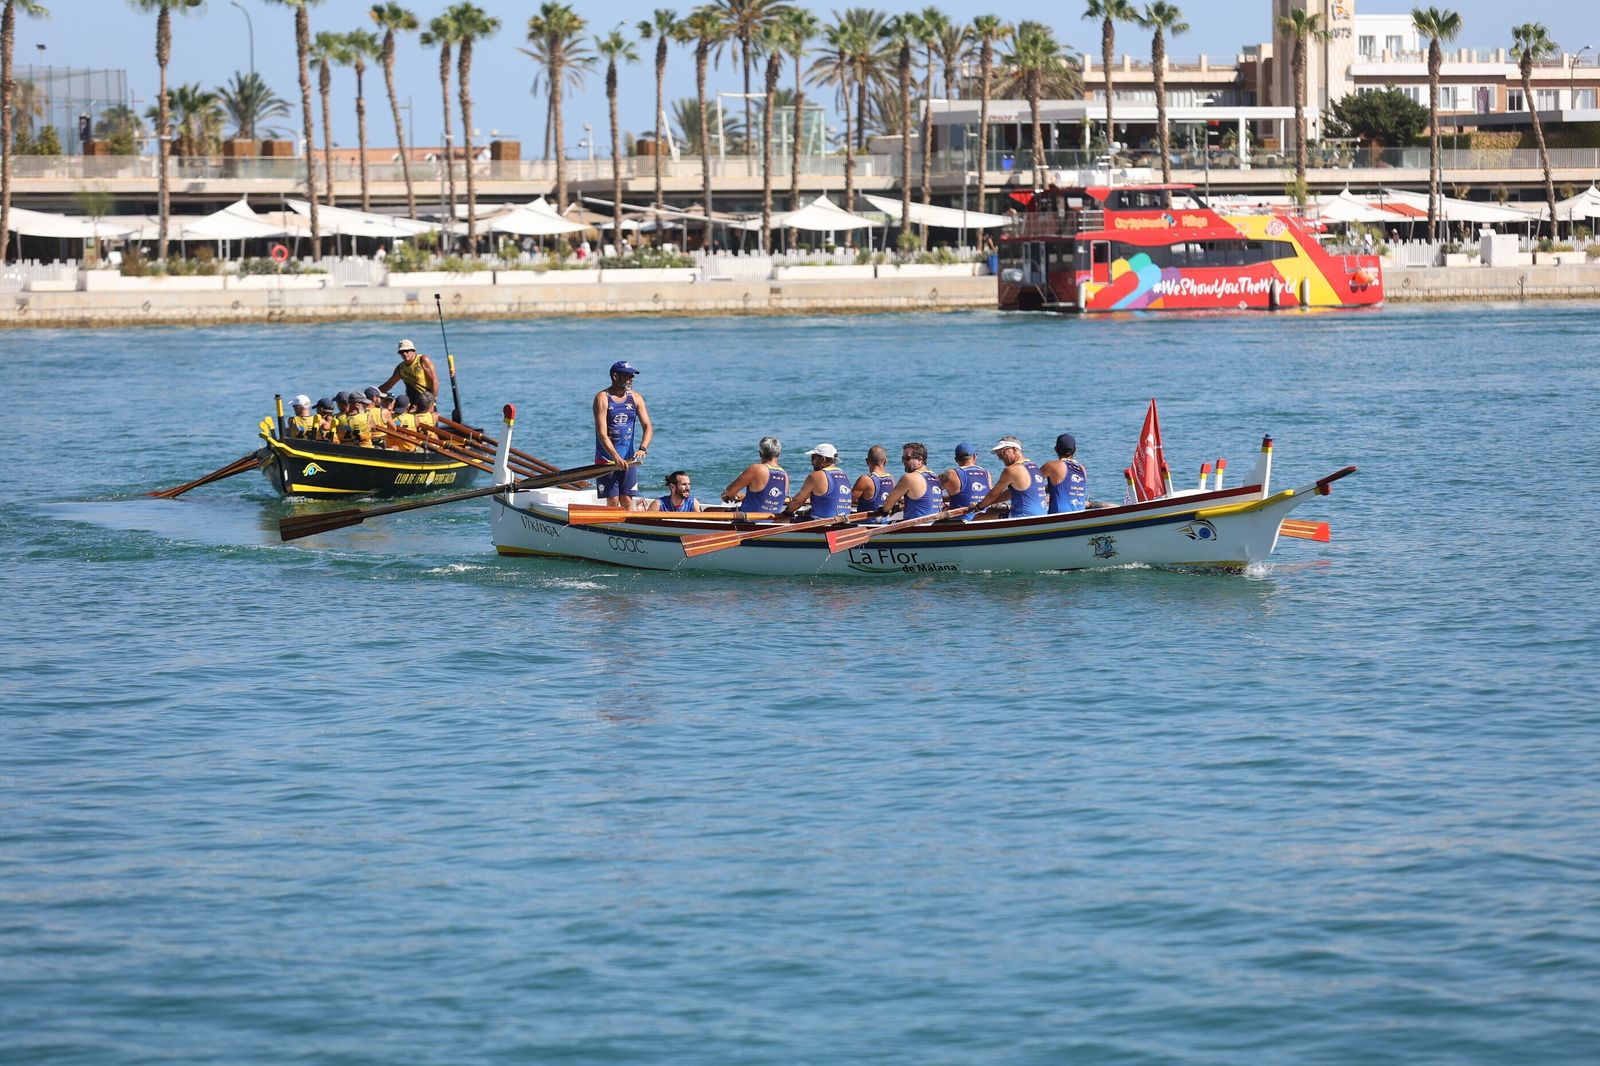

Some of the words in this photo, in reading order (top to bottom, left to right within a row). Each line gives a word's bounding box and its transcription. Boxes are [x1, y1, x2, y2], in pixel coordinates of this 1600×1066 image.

[1152, 276, 1297, 299] #WeShowYouTheWrld
[848, 547, 873, 565] La
[877, 547, 918, 565] Flor
[902, 564, 916, 573] de
